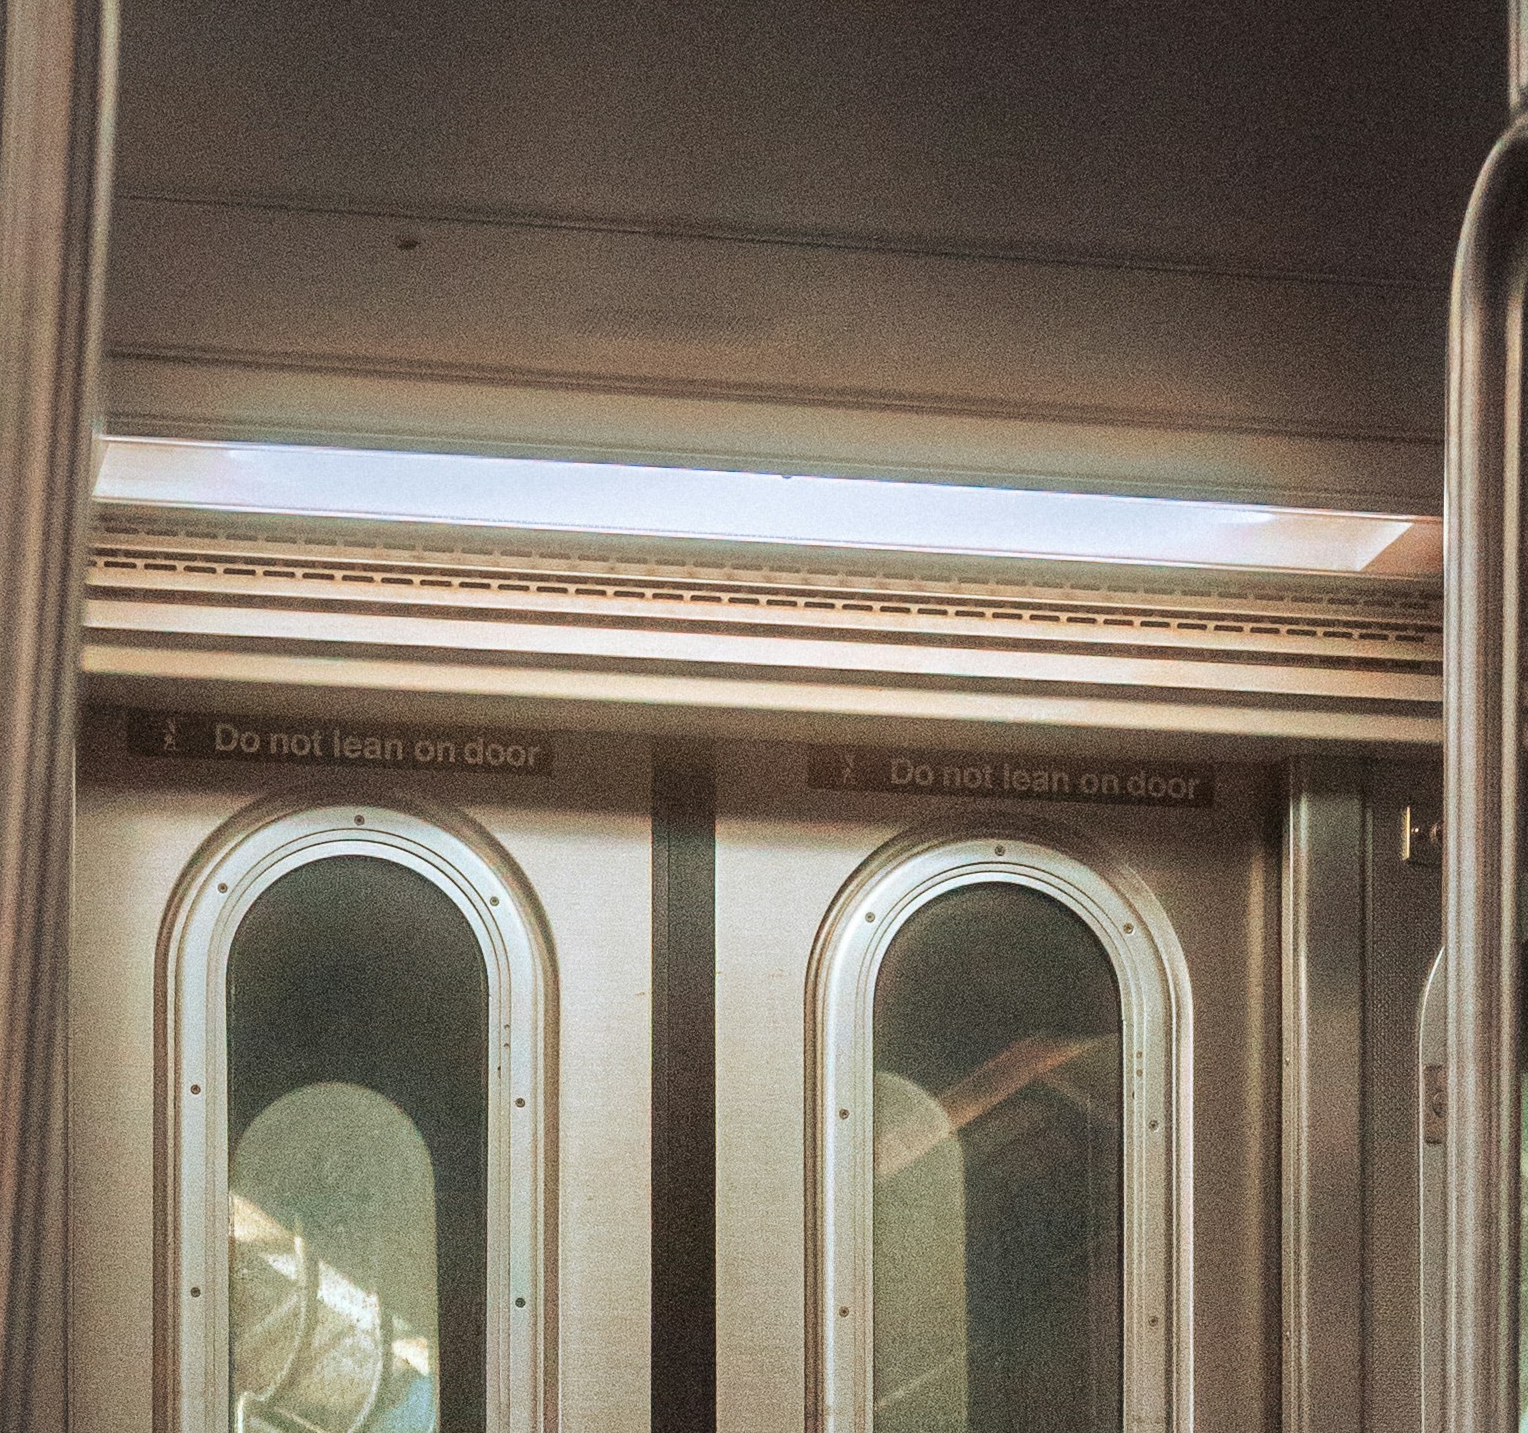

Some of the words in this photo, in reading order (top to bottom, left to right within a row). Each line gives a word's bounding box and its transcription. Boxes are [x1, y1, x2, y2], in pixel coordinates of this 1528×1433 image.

[214, 721, 261, 754] Do
[269, 726, 323, 757] not
[332, 727, 404, 761] lean
[414, 739, 455, 763] on
[463, 736, 540, 767] door
[889, 757, 935, 787] Do
[942, 762, 994, 790] not
[1001, 762, 1070, 793] lean
[1078, 772, 1120, 795] on
[1126, 769, 1201, 800] door
